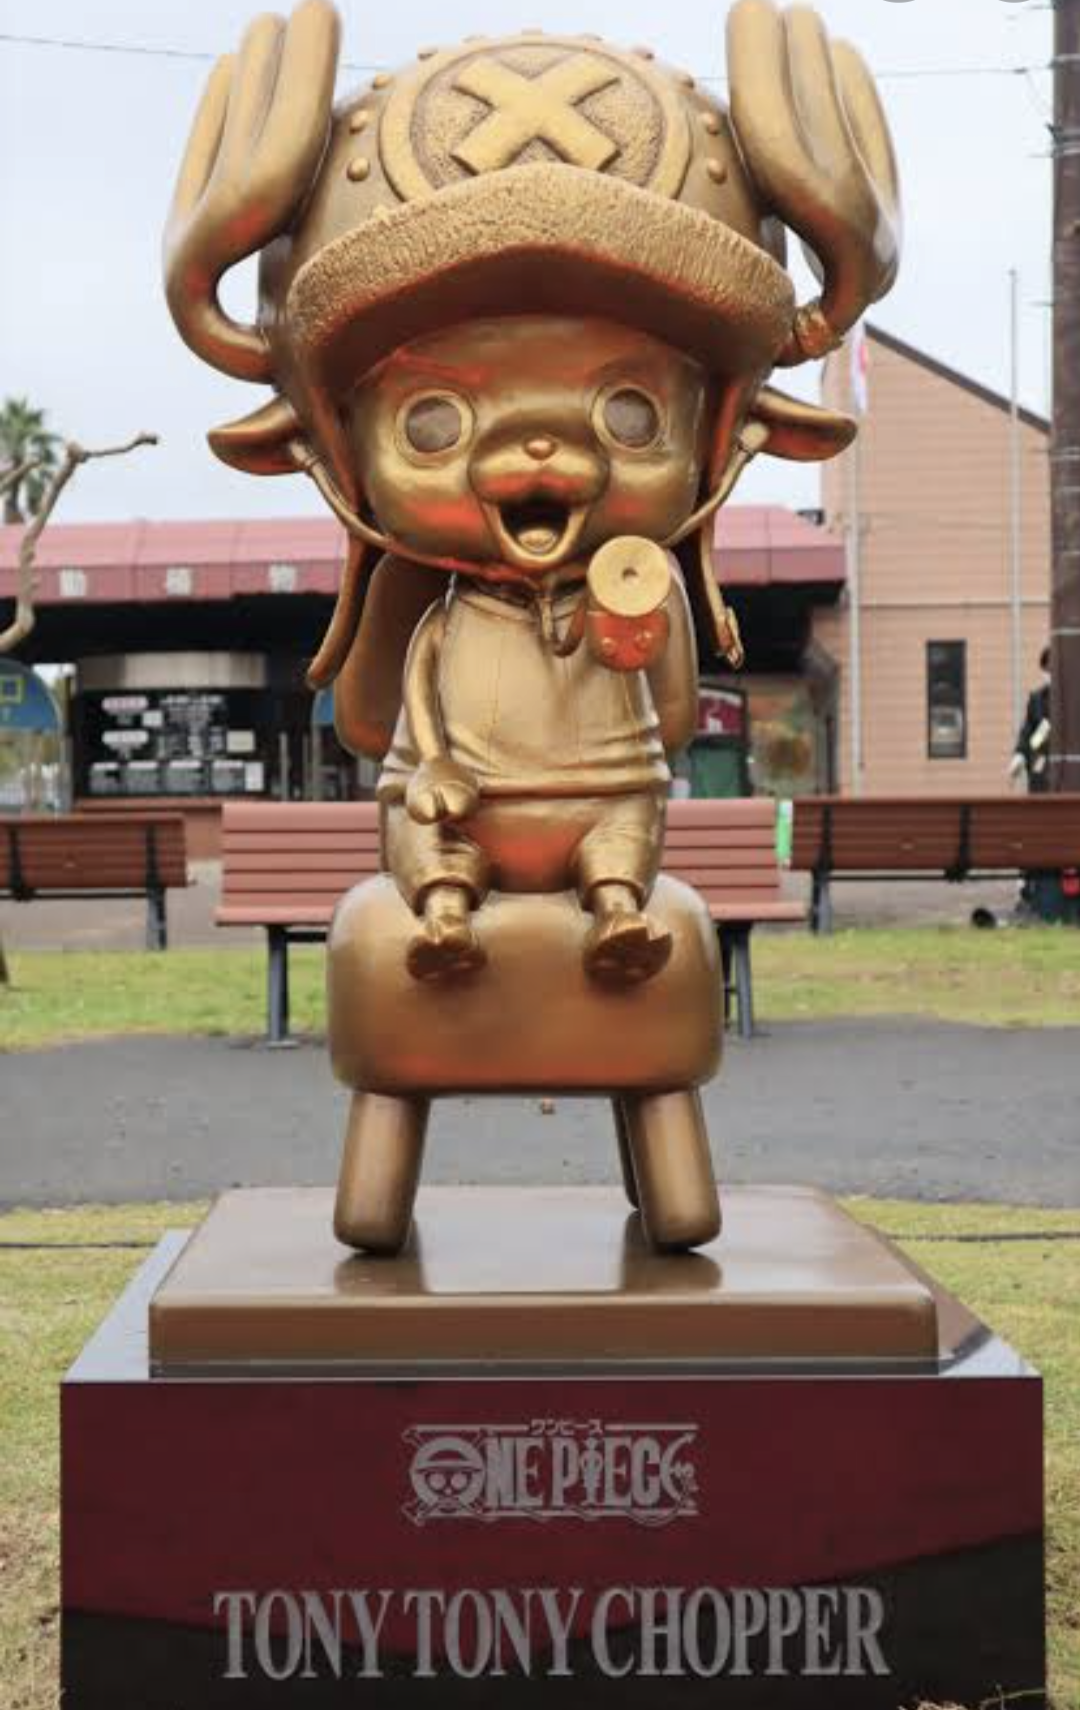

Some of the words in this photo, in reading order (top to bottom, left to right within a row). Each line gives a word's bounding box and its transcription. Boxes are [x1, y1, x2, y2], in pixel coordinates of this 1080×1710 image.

[530, 1418, 604, 1437] ワンピース
[551, 1432, 698, 1507] PIECE
[213, 1589, 389, 1680] TONY
[403, 1588, 584, 1679] TONY
[591, 1586, 891, 1678] CHOPPER
